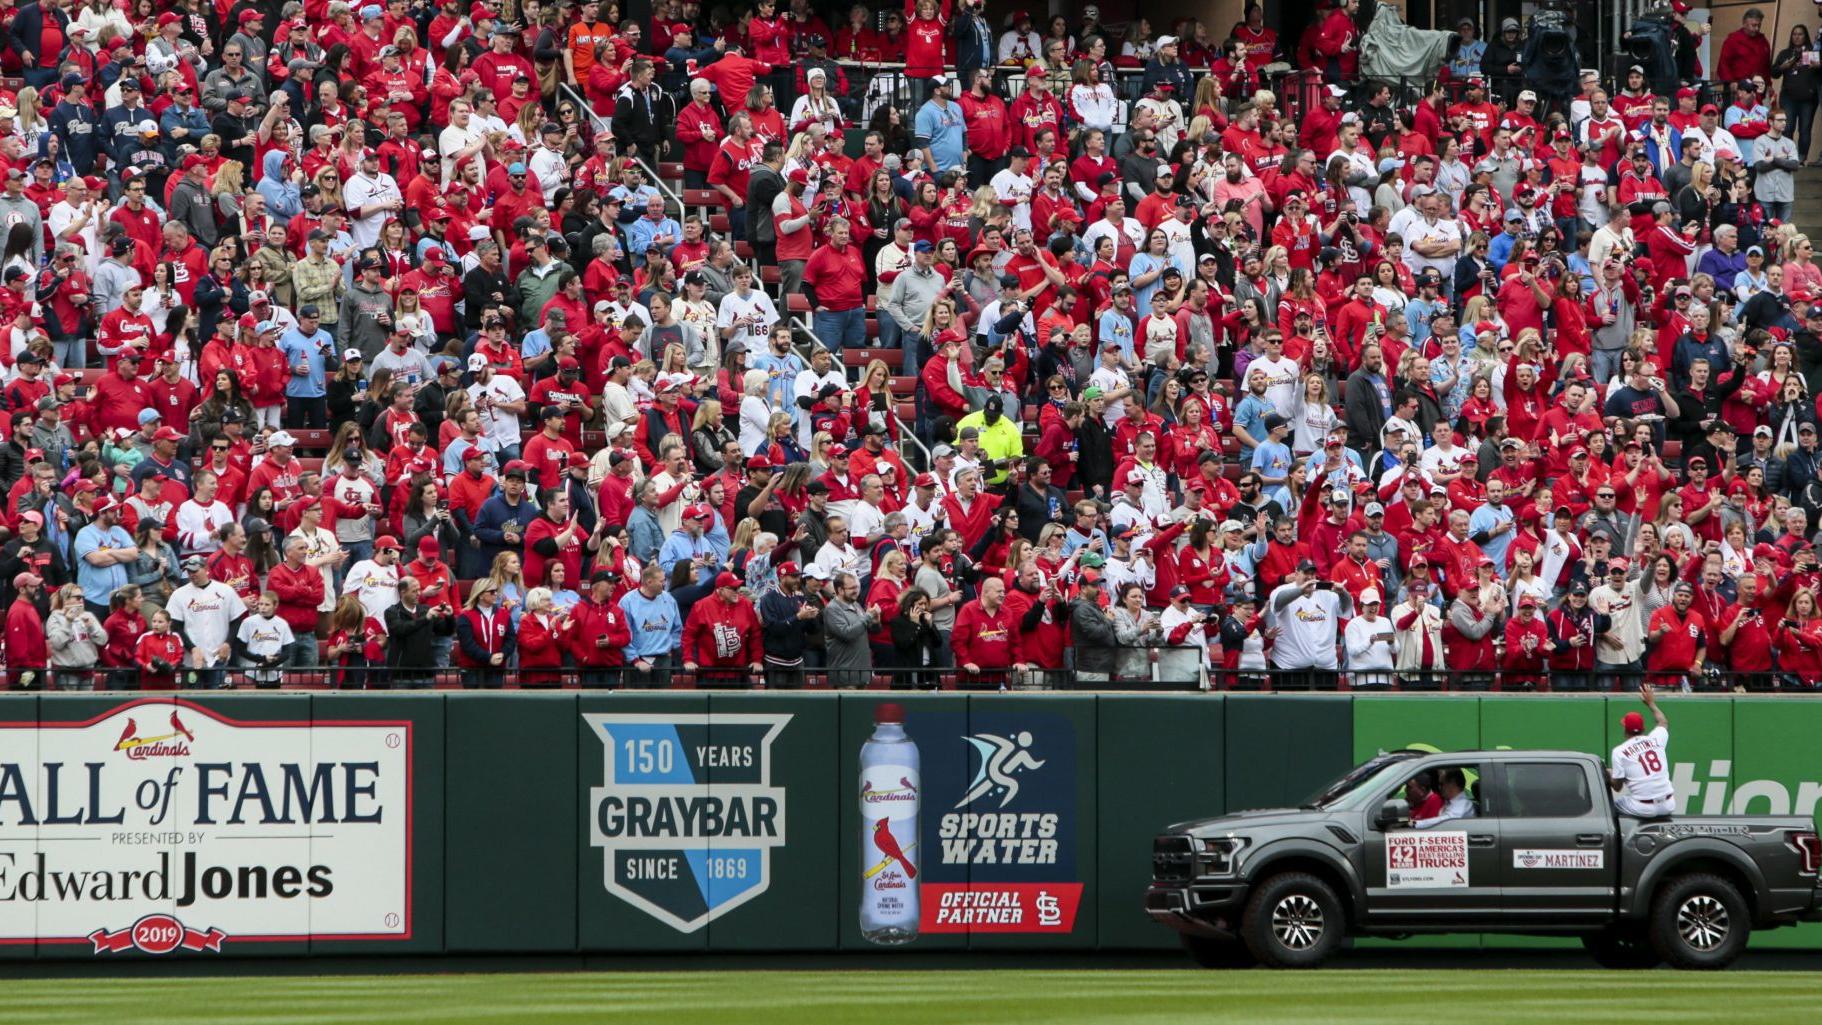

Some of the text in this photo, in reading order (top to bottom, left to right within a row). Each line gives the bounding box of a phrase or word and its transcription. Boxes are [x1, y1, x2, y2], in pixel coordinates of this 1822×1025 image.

[755, 325, 768, 336] 66
[126, 740, 190, 760] Cardinals
[624, 739, 753, 773] 150 YEARS
[1638, 750, 1662, 775] 18
[136, 767, 183, 826] of
[193, 761, 383, 825] FAME
[864, 791, 916, 804] Cardinals
[599, 796, 778, 838] GRAYBAR
[939, 813, 1059, 840] SPORTS
[112, 832, 205, 845] PRESENTED BY
[1389, 836, 1465, 846] FORD F-SERIES
[941, 839, 1058, 865] WATER
[1392, 846, 1415, 863] 42
[1419, 845, 1465, 853] AMERICA'S
[627, 858, 747, 880] SINCE 1869
[1419, 858, 1466, 869] TRUCKS
[940, 892, 1021, 909] OFFICIAL
[936, 908, 1023, 925] PARTNER
[138, 925, 178, 945] 2019
